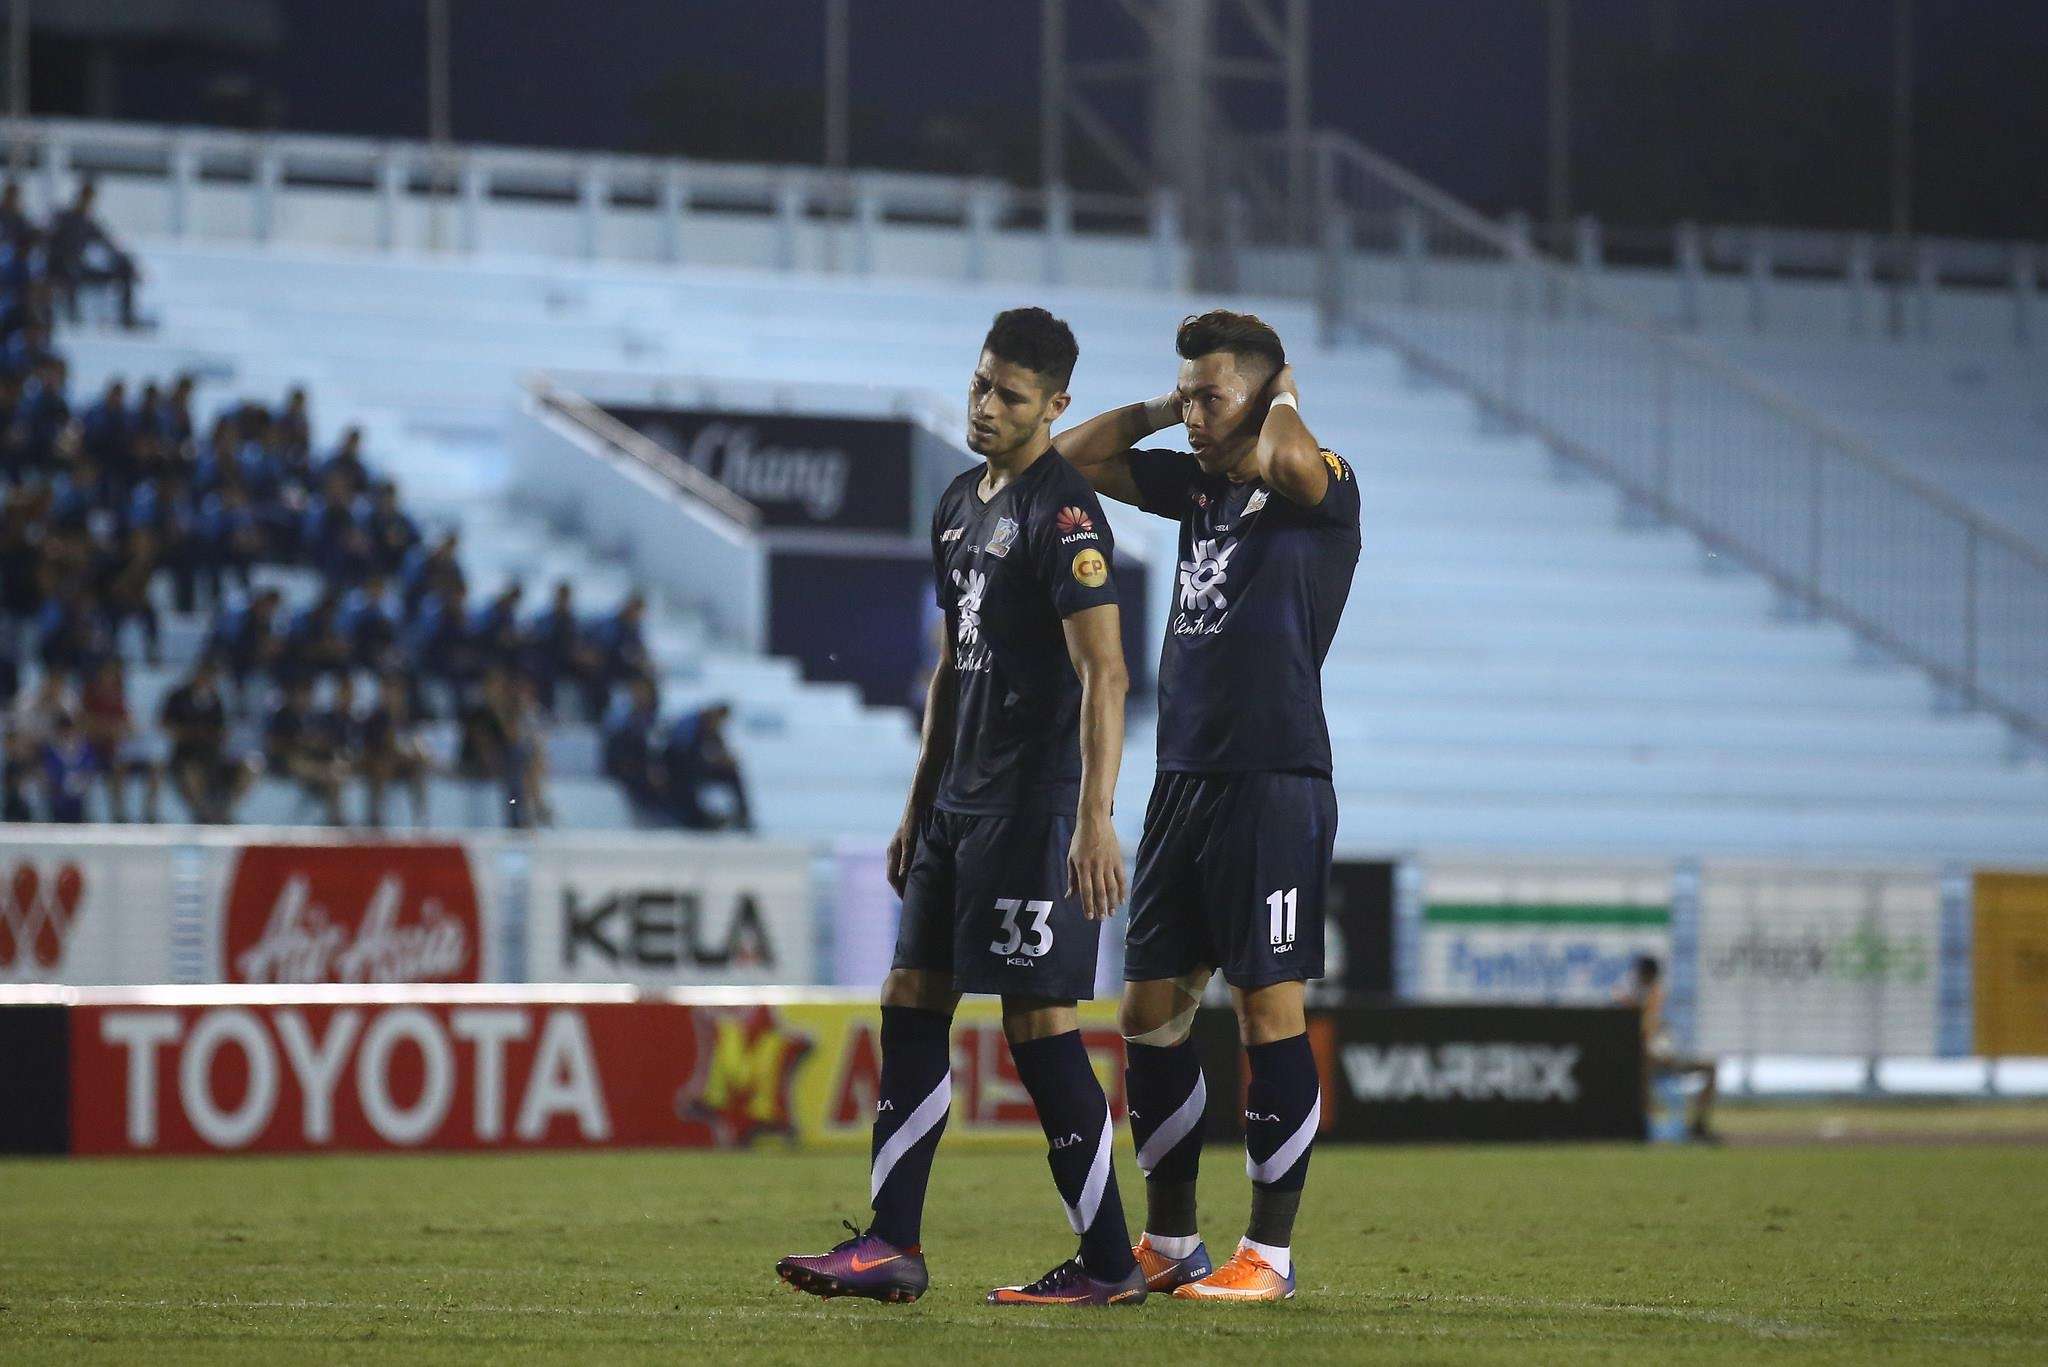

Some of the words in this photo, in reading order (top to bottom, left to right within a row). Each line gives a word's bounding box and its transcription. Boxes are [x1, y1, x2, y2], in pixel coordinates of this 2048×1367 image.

[1061, 531, 1099, 545] HUAWEI
[1079, 559, 1103, 577] CP
[1173, 611, 1229, 636] Central
[560, 886, 774, 970] KELA
[989, 898, 1054, 957] 33
[1266, 887, 1297, 945] 11
[1006, 957, 1034, 967] KELA
[1273, 943, 1293, 954] KELA
[101, 1006, 611, 1148] TOYOTA
[1343, 1043, 1582, 1102] WARRIX
